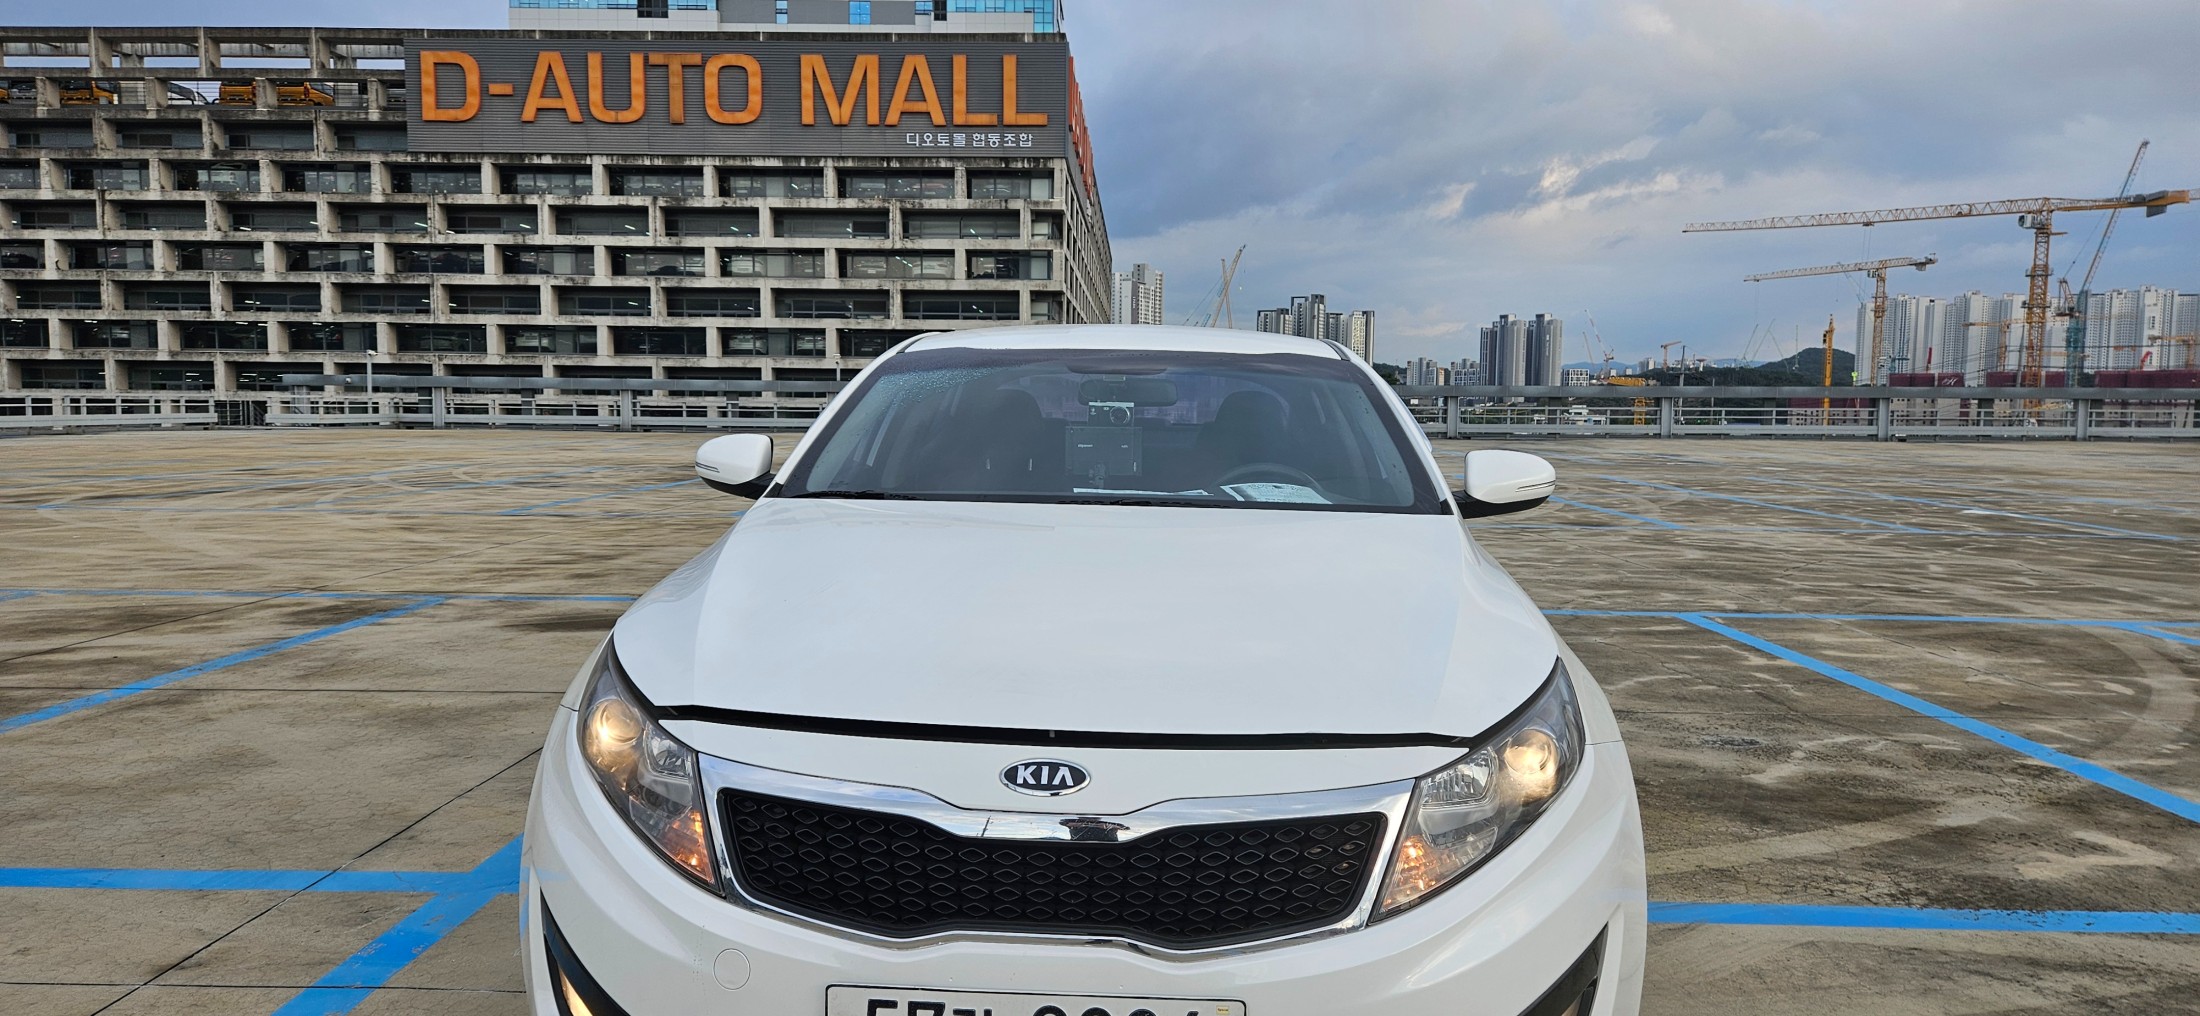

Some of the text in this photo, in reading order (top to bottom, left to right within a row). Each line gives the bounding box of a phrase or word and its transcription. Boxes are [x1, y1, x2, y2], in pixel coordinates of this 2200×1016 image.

[420, 50, 763, 124] D-AUTO
[800, 53, 1048, 126] MALL
[906, 132, 1034, 148] 디오토몰 협동조합
[1016, 765, 1074, 786] KIA
